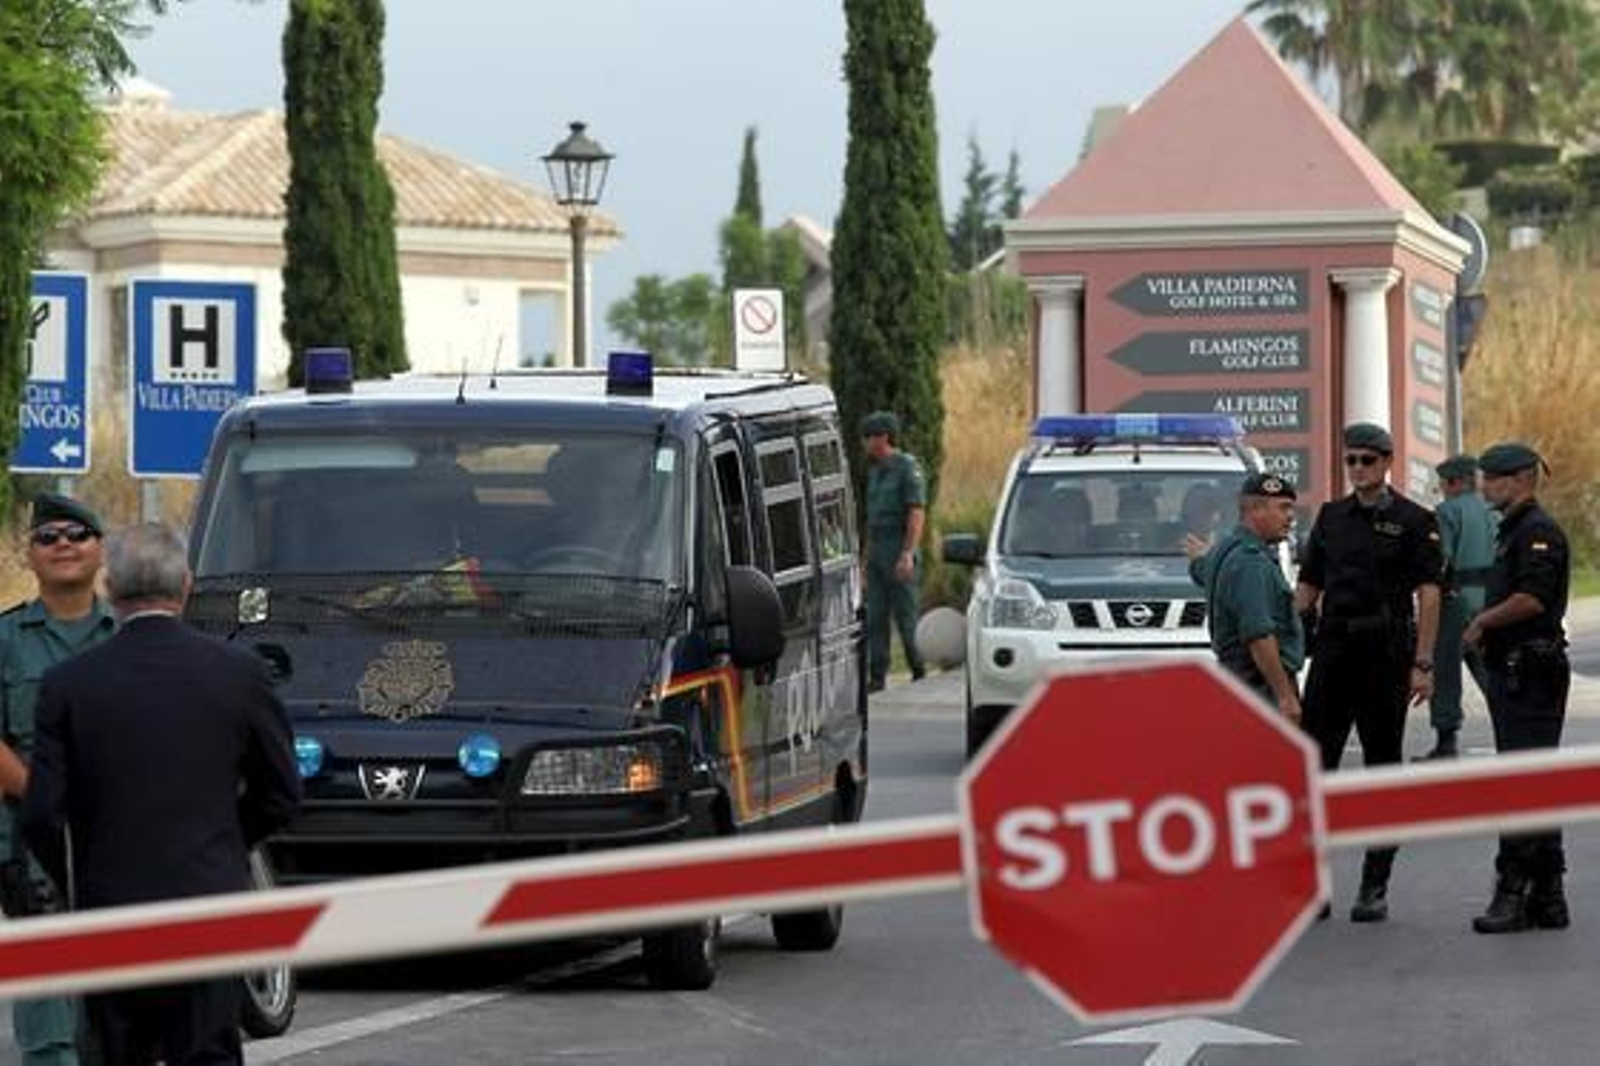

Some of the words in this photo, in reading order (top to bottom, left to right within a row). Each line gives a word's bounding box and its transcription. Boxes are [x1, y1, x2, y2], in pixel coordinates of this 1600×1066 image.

[1147, 277, 1199, 295] VILLA
[1204, 276, 1297, 294] PADIERNA
[1169, 295, 1205, 309] GOLF
[1209, 295, 1254, 308] HOTEL
[1273, 294, 1298, 307] SPA
[169, 304, 219, 368] H
[1189, 336, 1299, 355] FLAMINGOS
[1222, 355, 1259, 369] GOLF
[1261, 354, 1299, 368] CLUB
[1213, 396, 1299, 412] ALFERINI
[19, 404, 80, 430] INGOS
[1262, 454, 1299, 472] GOS
[994, 783, 1293, 891] STOP
